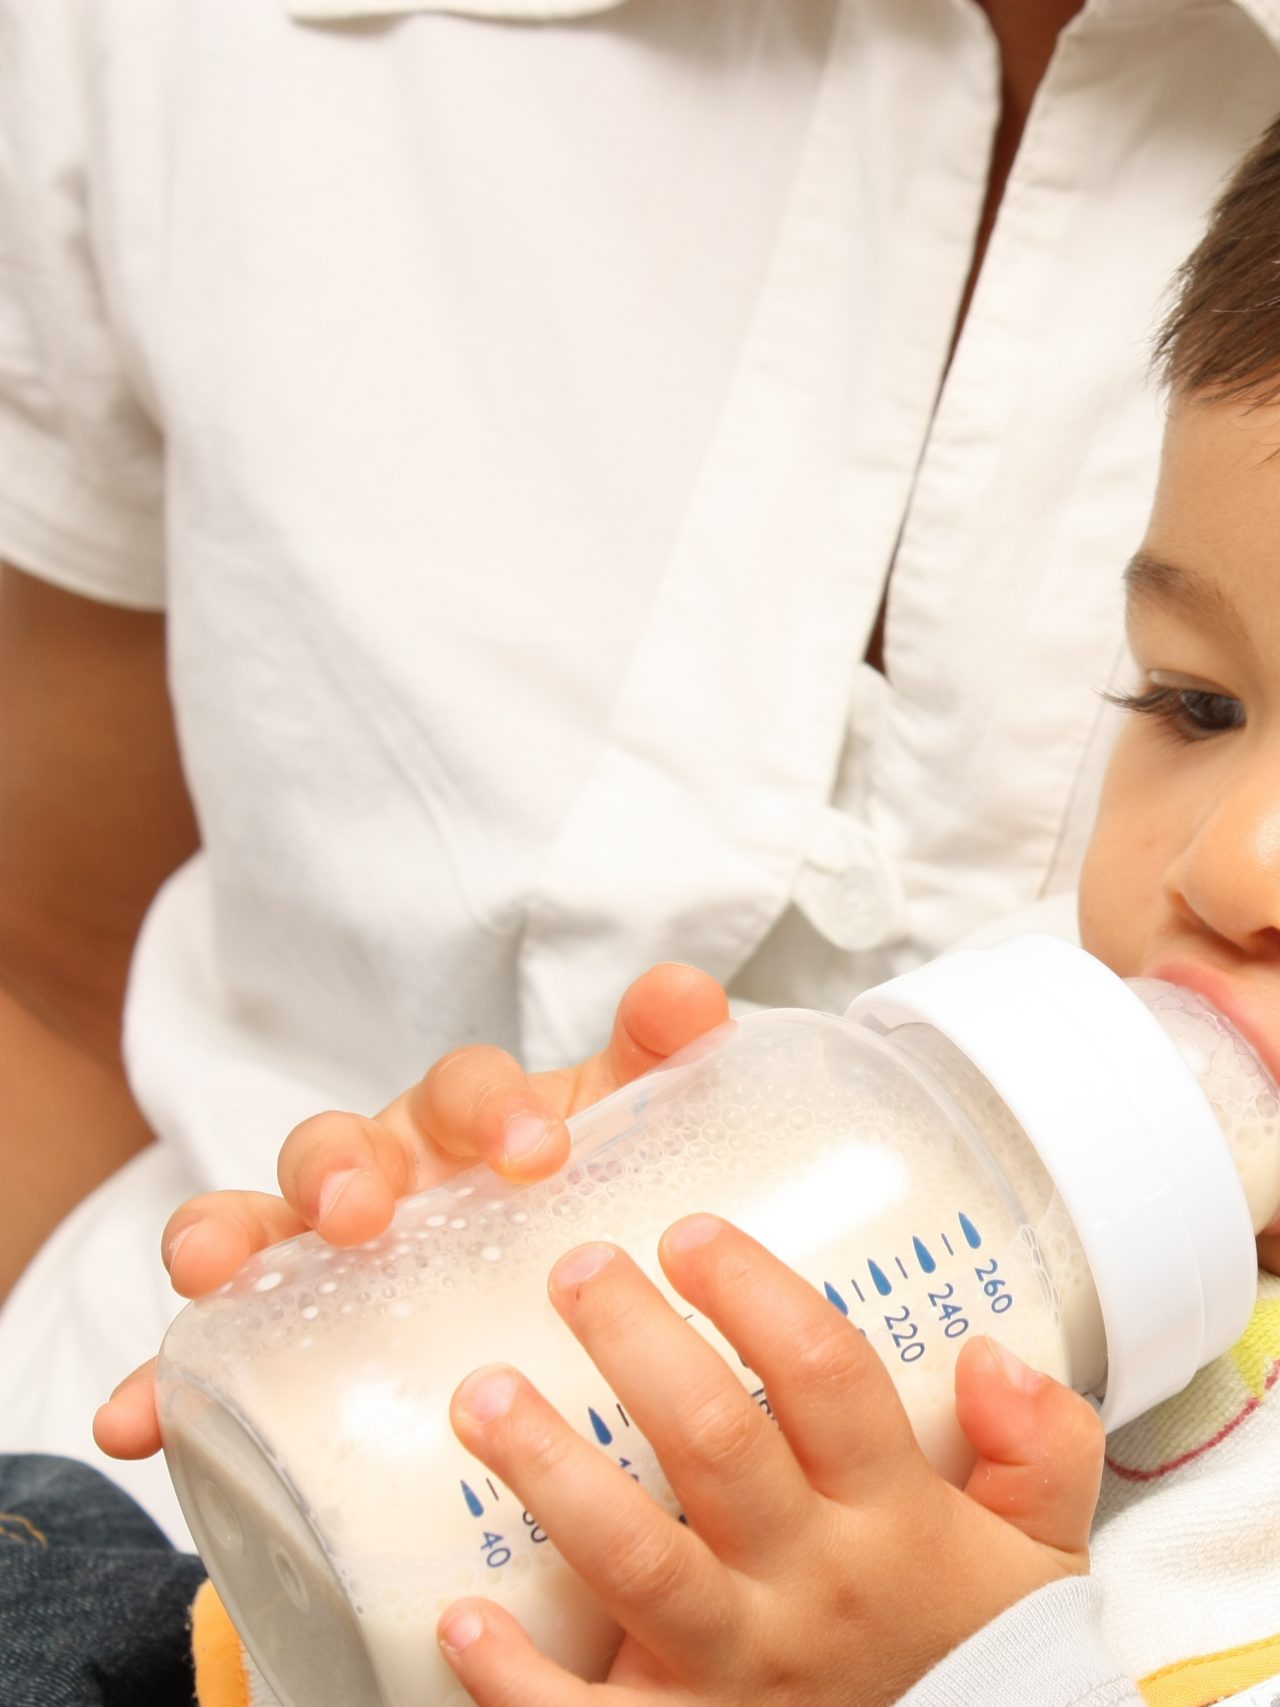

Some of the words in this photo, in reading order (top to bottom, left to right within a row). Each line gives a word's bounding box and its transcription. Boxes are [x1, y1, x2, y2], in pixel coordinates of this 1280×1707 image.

[928, 1283, 969, 1338] 240
[975, 1259, 1013, 1313] 260
[884, 1305, 925, 1362] 220
[480, 1532, 511, 1568] 40
